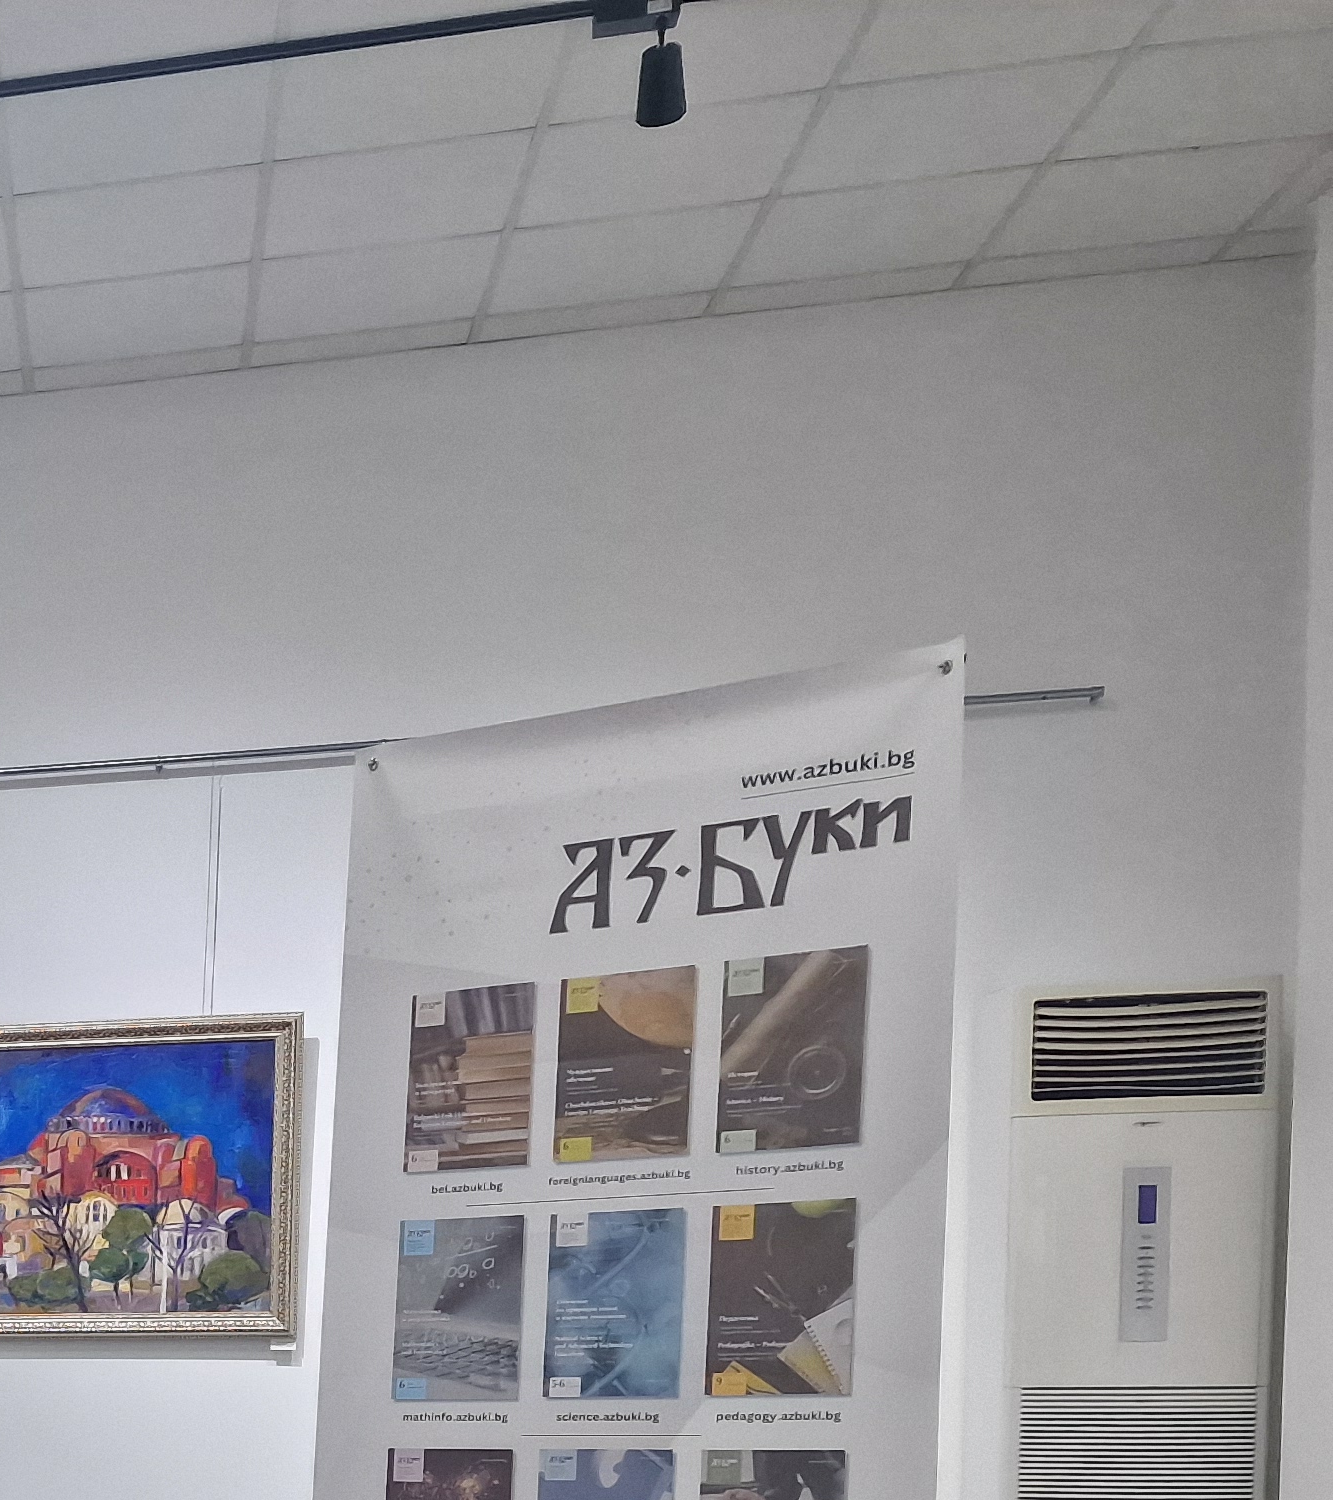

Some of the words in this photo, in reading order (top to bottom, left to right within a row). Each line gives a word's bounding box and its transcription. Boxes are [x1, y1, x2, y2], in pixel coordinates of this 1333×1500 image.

[741, 749, 915, 790] www.azbuki.bg
[736, 1159, 844, 1176] history.azbuki.bg
[548, 1169, 691, 1187] foreignlanguages.azbuki.bg
[431, 1182, 503, 1195] bel.azbuki.bg
[403, 1411, 508, 1423] mathinfo.azbuki.bg
[556, 1411, 660, 1424] science.azbuki.bg
[716, 1411, 842, 1423] pedagogy.azbuki.bg
